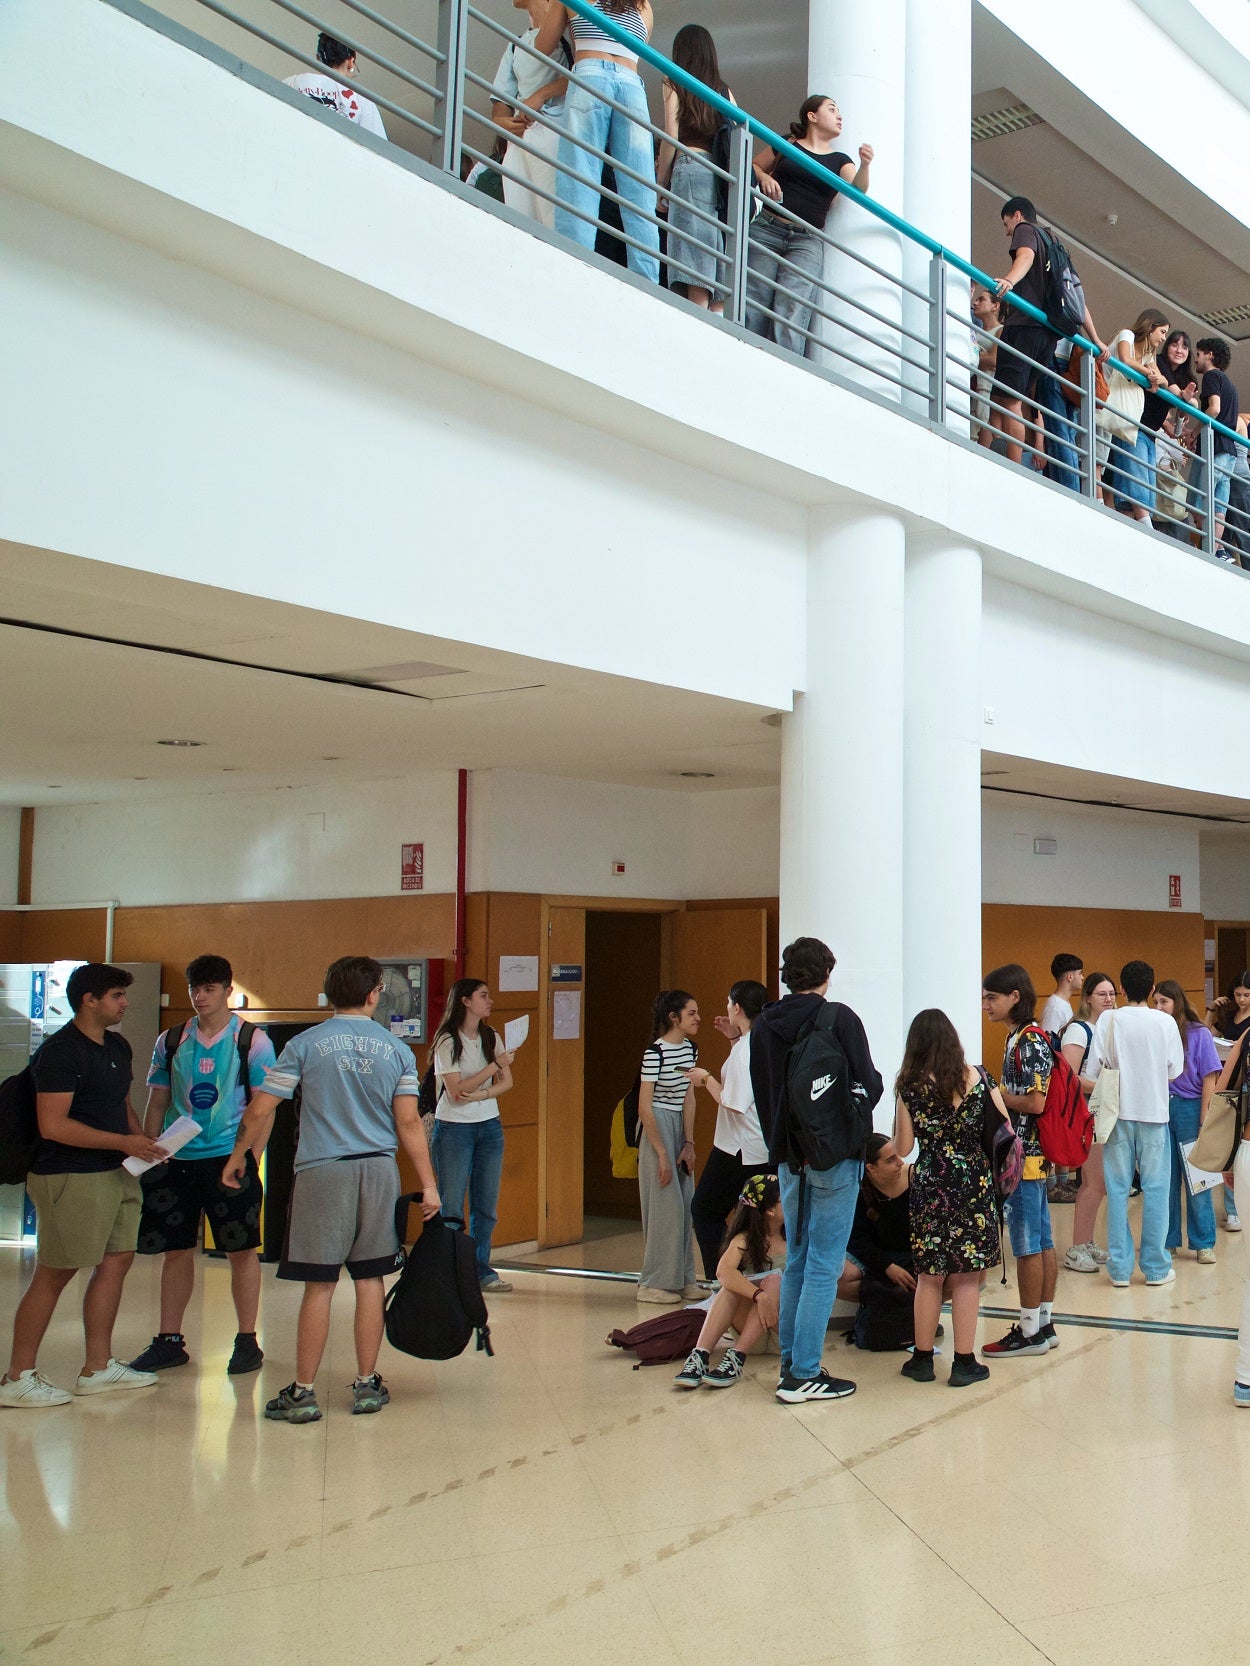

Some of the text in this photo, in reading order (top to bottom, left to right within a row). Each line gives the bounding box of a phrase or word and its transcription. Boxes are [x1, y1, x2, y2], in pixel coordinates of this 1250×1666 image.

[314, 1034, 395, 1060] EIGHTY
[338, 1055, 374, 1074] SIX
[812, 1073, 832, 1092] NIKE
